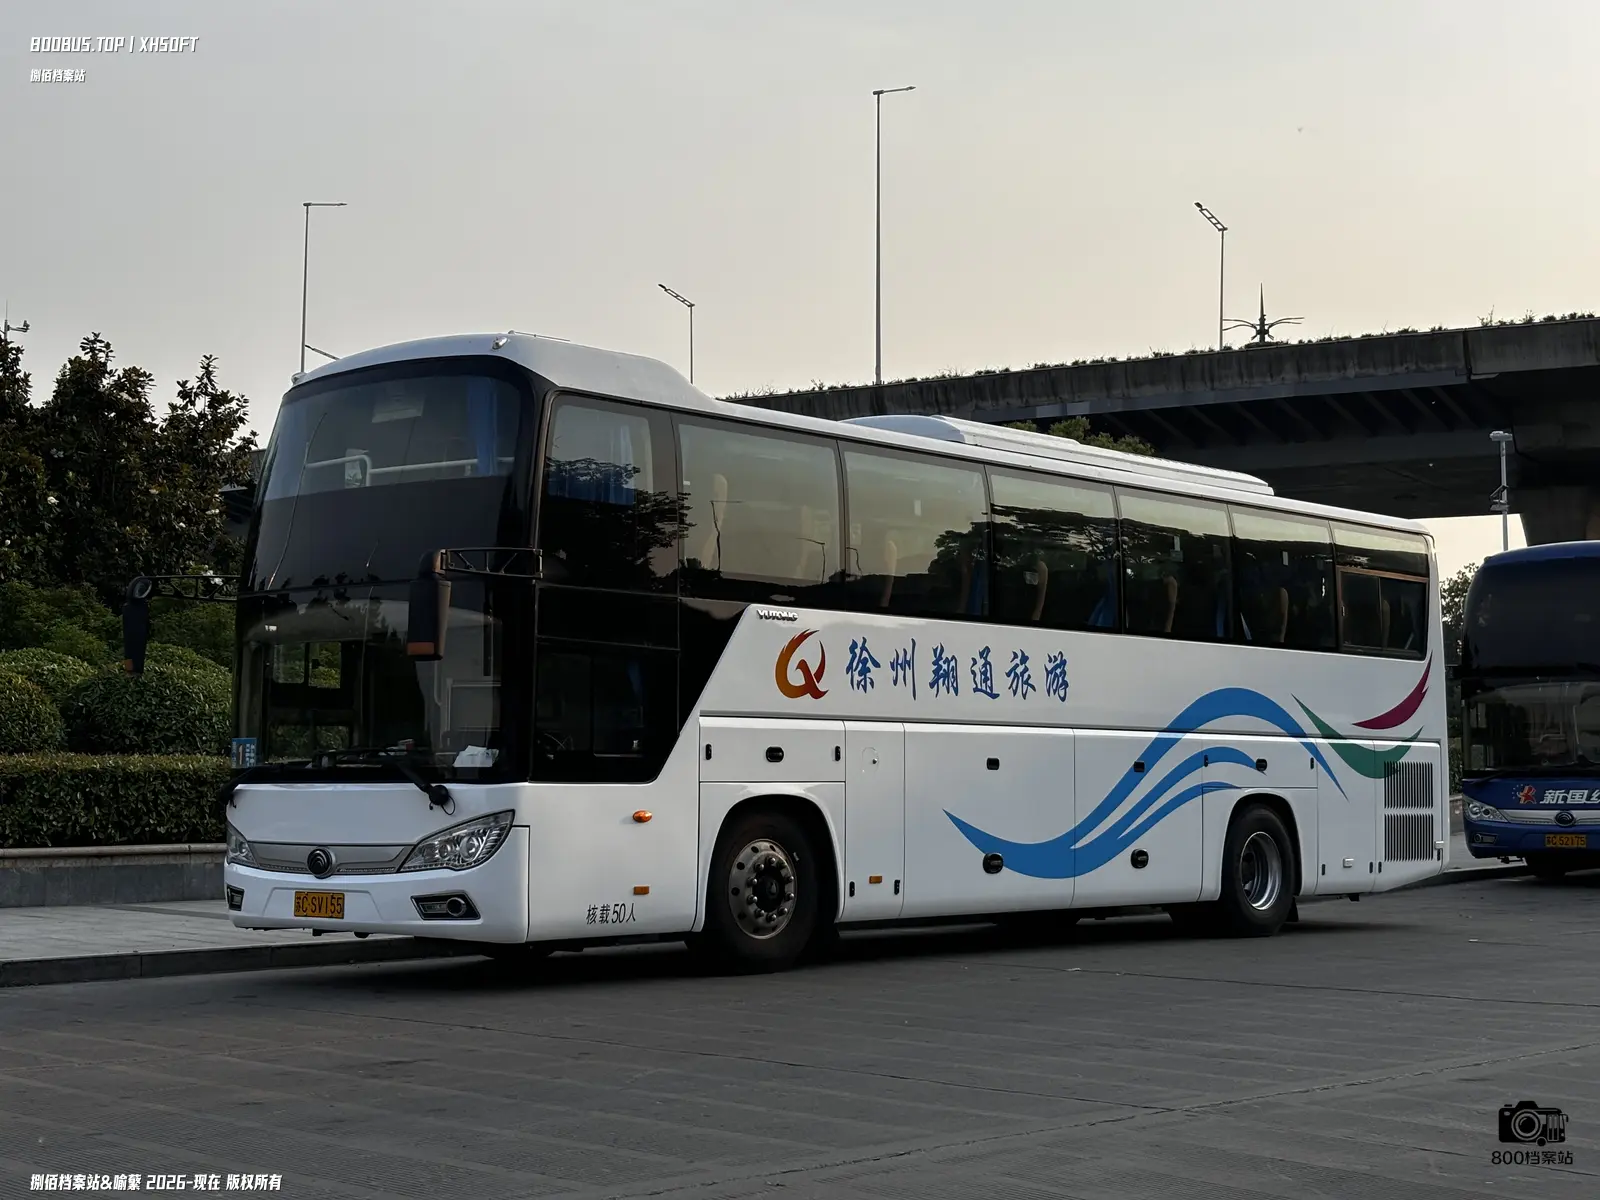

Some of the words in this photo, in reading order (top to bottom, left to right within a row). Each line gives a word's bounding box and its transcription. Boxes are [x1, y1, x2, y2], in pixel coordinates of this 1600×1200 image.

[756, 609, 799, 622] YUTONG
[845, 636, 1070, 702] 徐州翔通旅游
[586, 902, 636, 925] 核载50人
